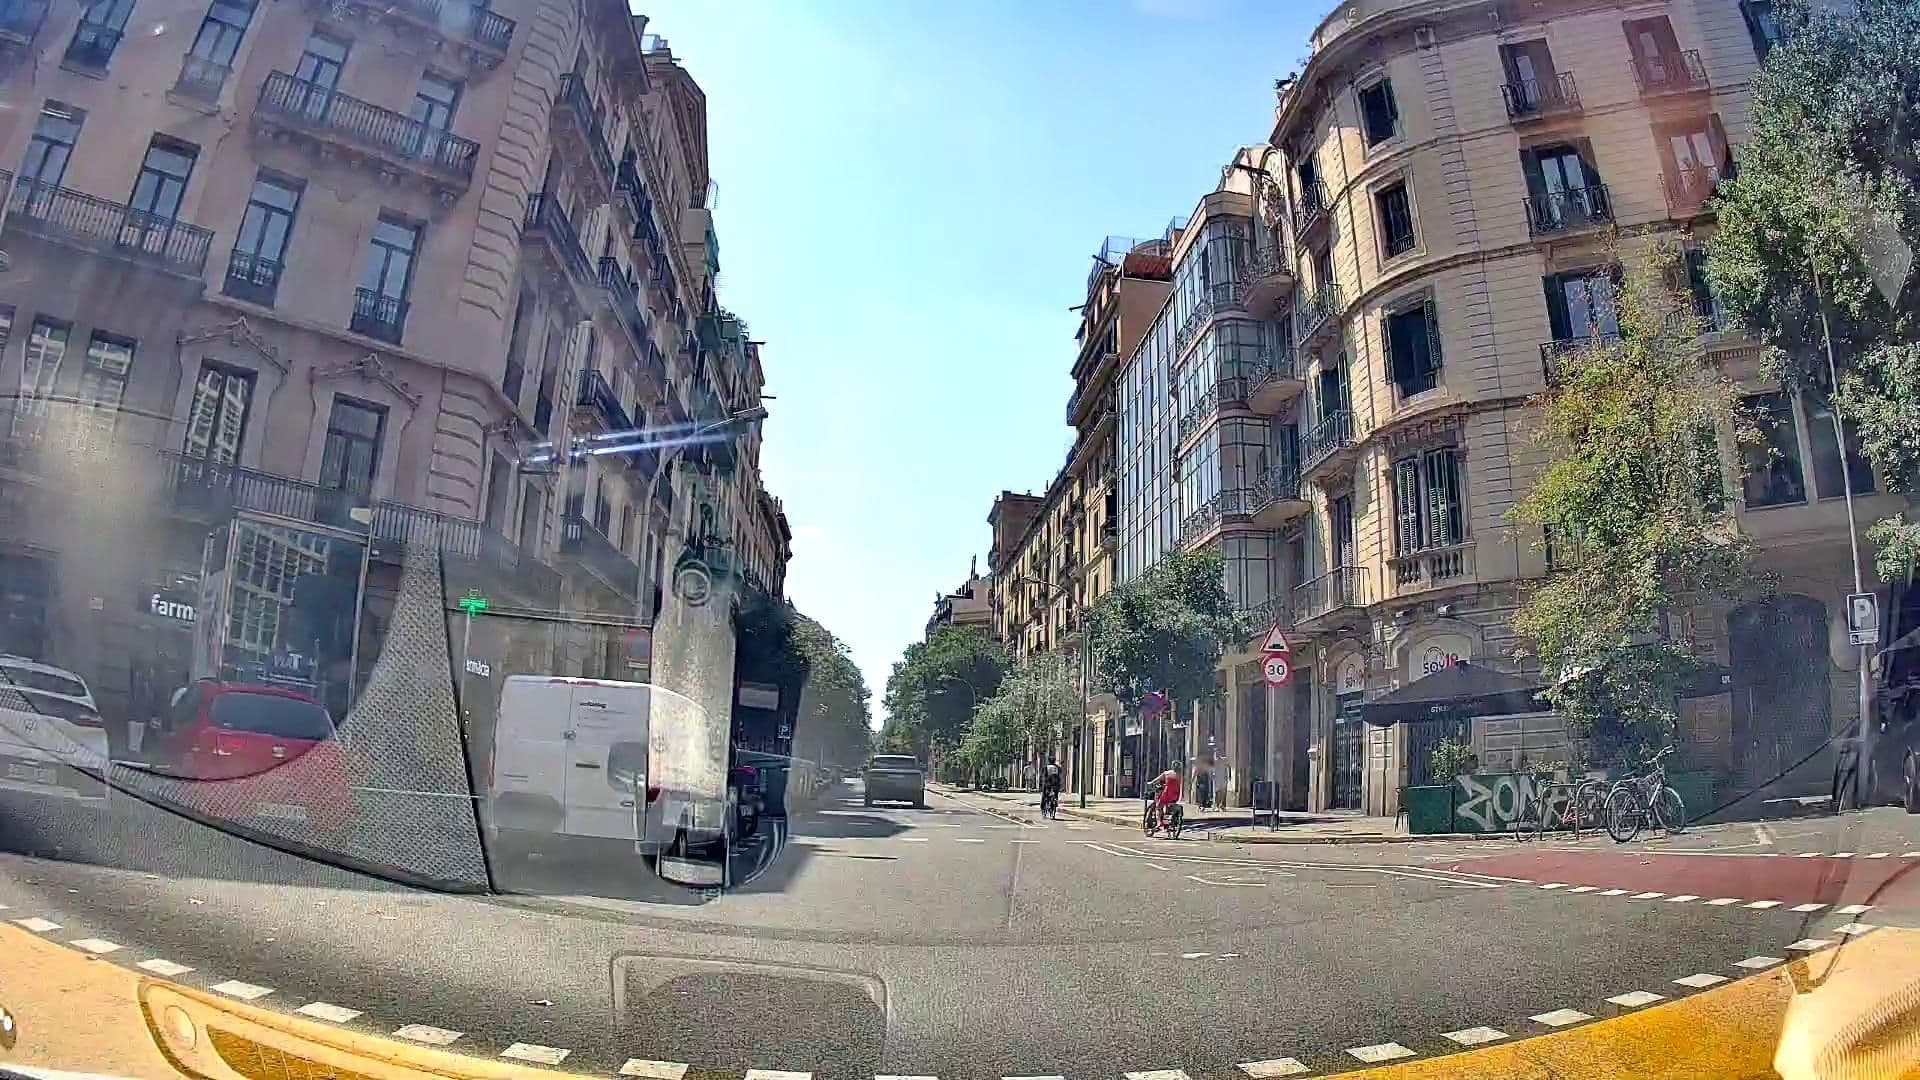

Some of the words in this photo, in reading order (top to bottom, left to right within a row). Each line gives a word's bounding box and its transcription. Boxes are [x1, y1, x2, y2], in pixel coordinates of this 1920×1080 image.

[151, 593, 197, 620] farm
[1854, 599, 1871, 627] P
[1267, 664, 1285, 676] 30
